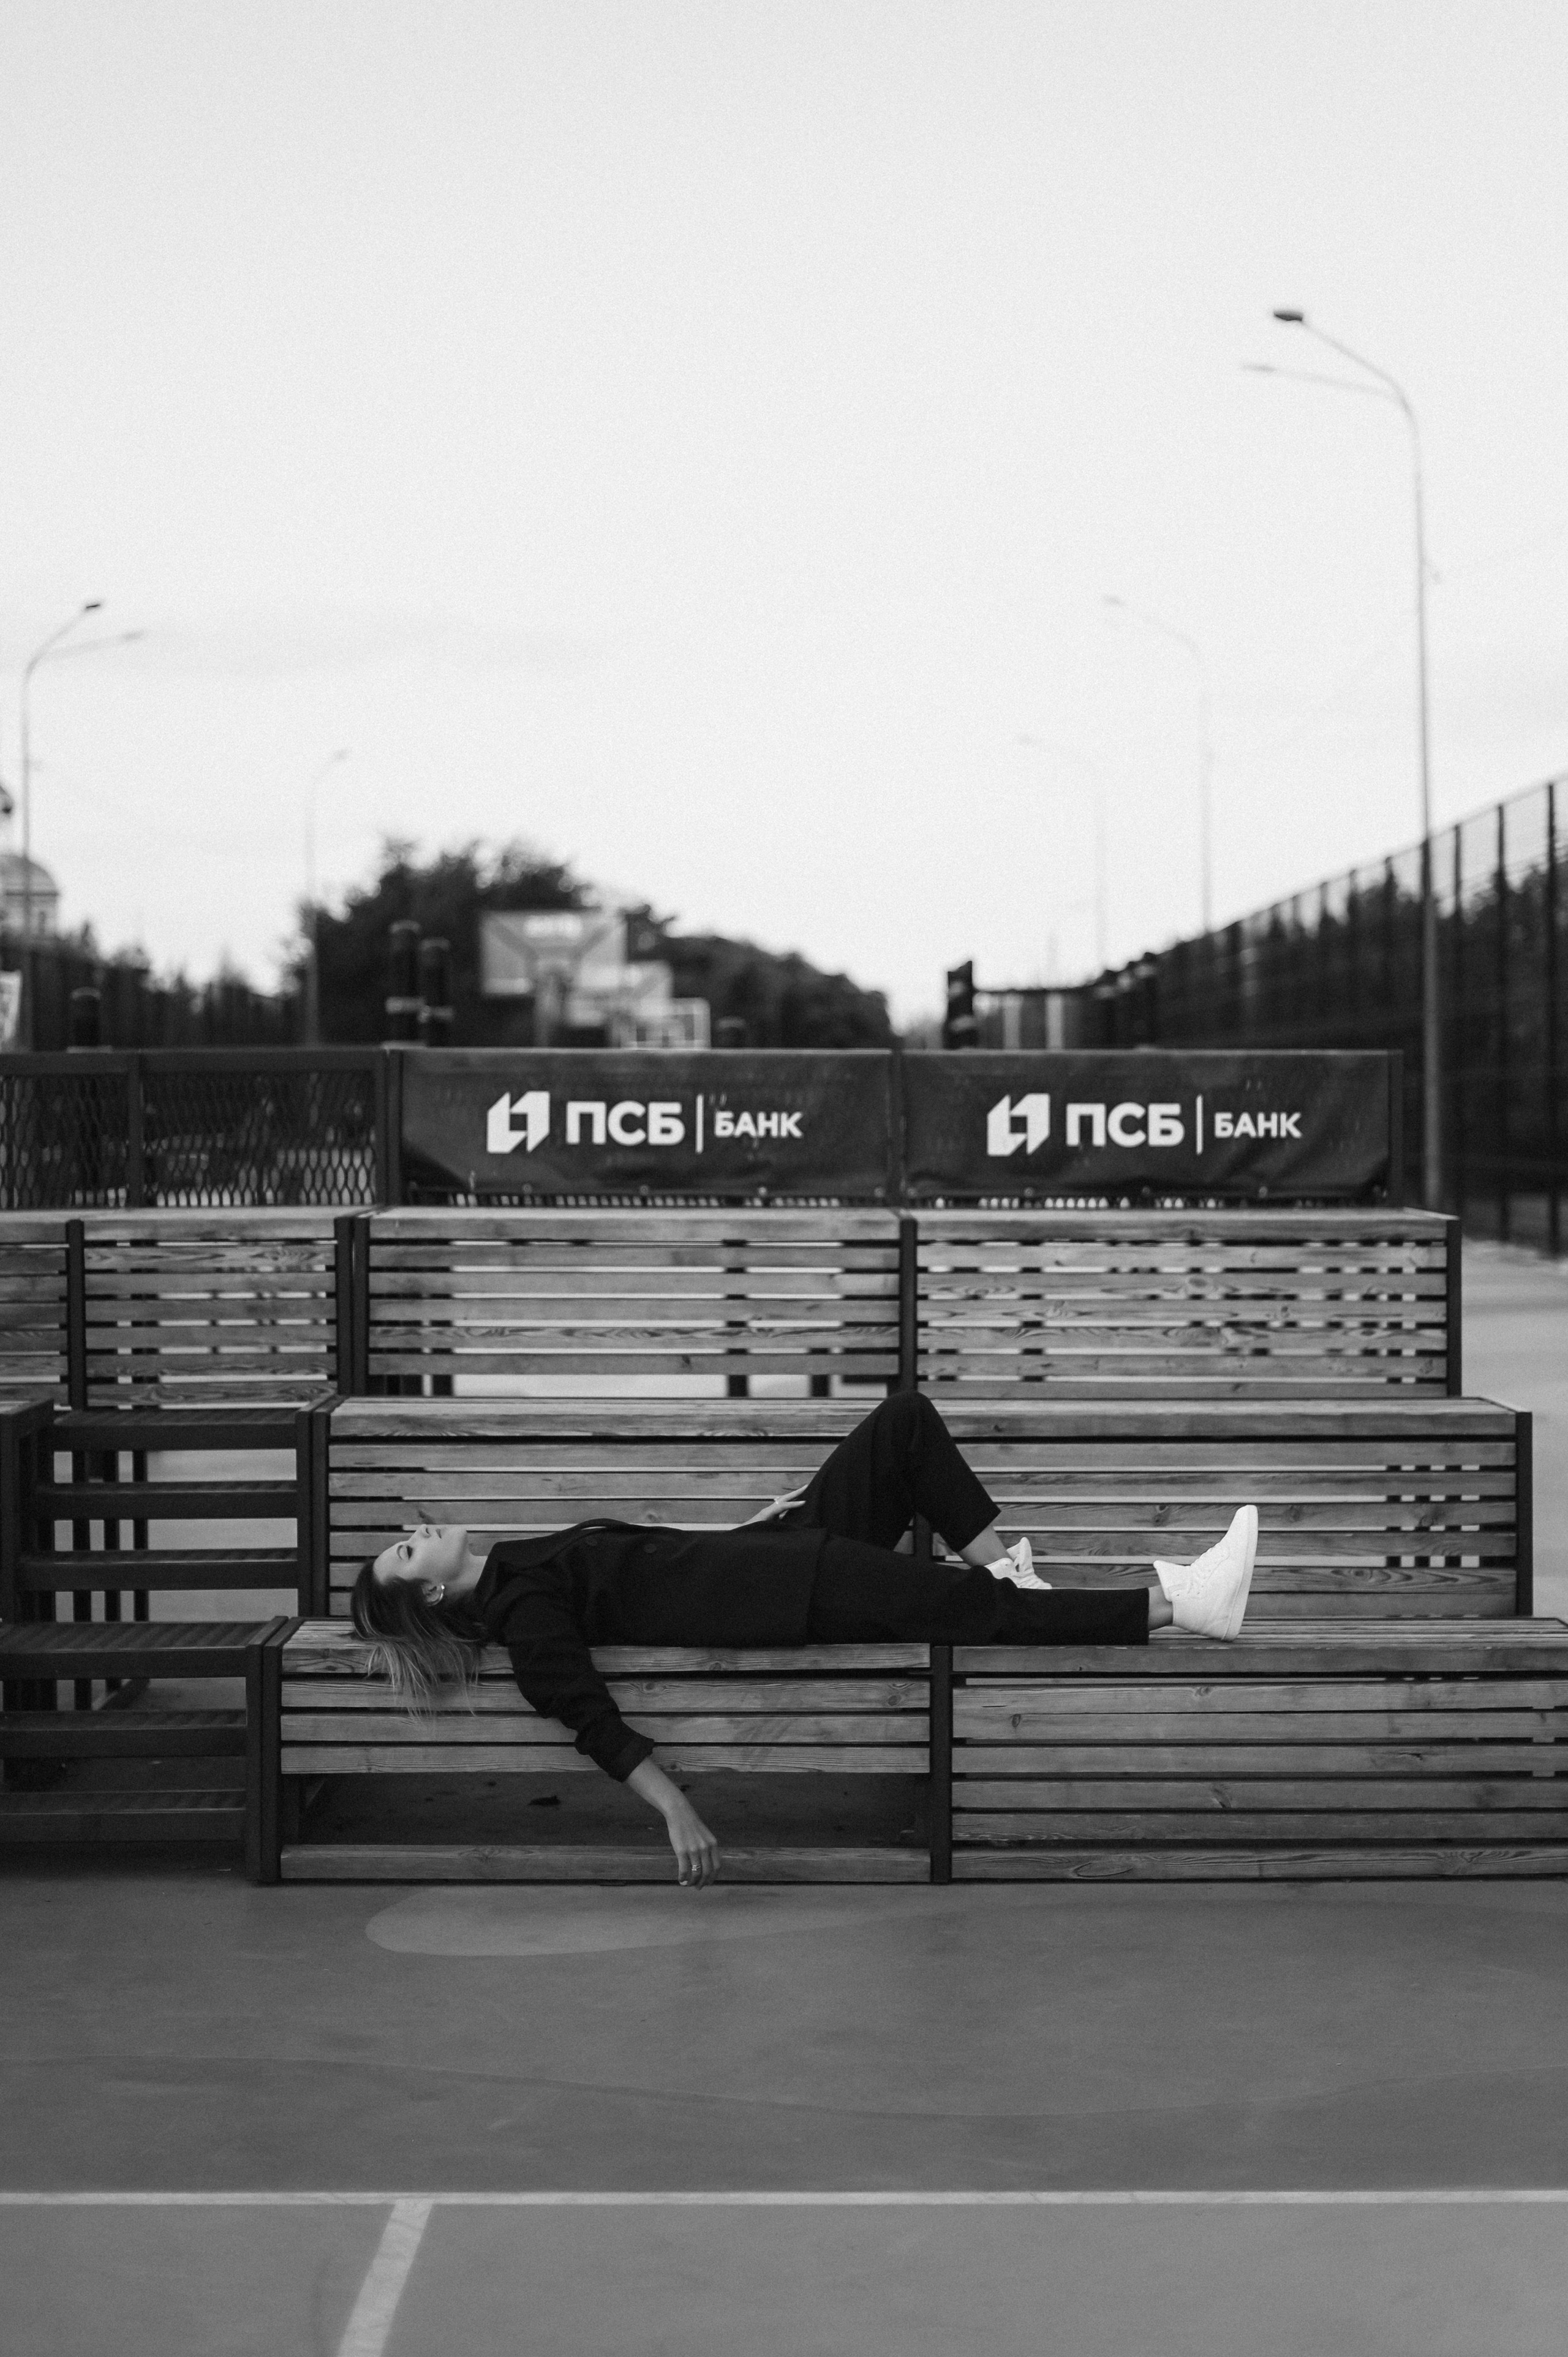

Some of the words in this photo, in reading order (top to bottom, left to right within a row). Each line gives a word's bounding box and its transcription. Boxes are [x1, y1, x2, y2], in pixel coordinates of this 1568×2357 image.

[566, 1101, 685, 1145] ПСБ
[714, 1111, 803, 1138] БАНК
[1066, 1102, 1185, 1147] ПСБ
[1215, 1112, 1302, 1138] БАНК
